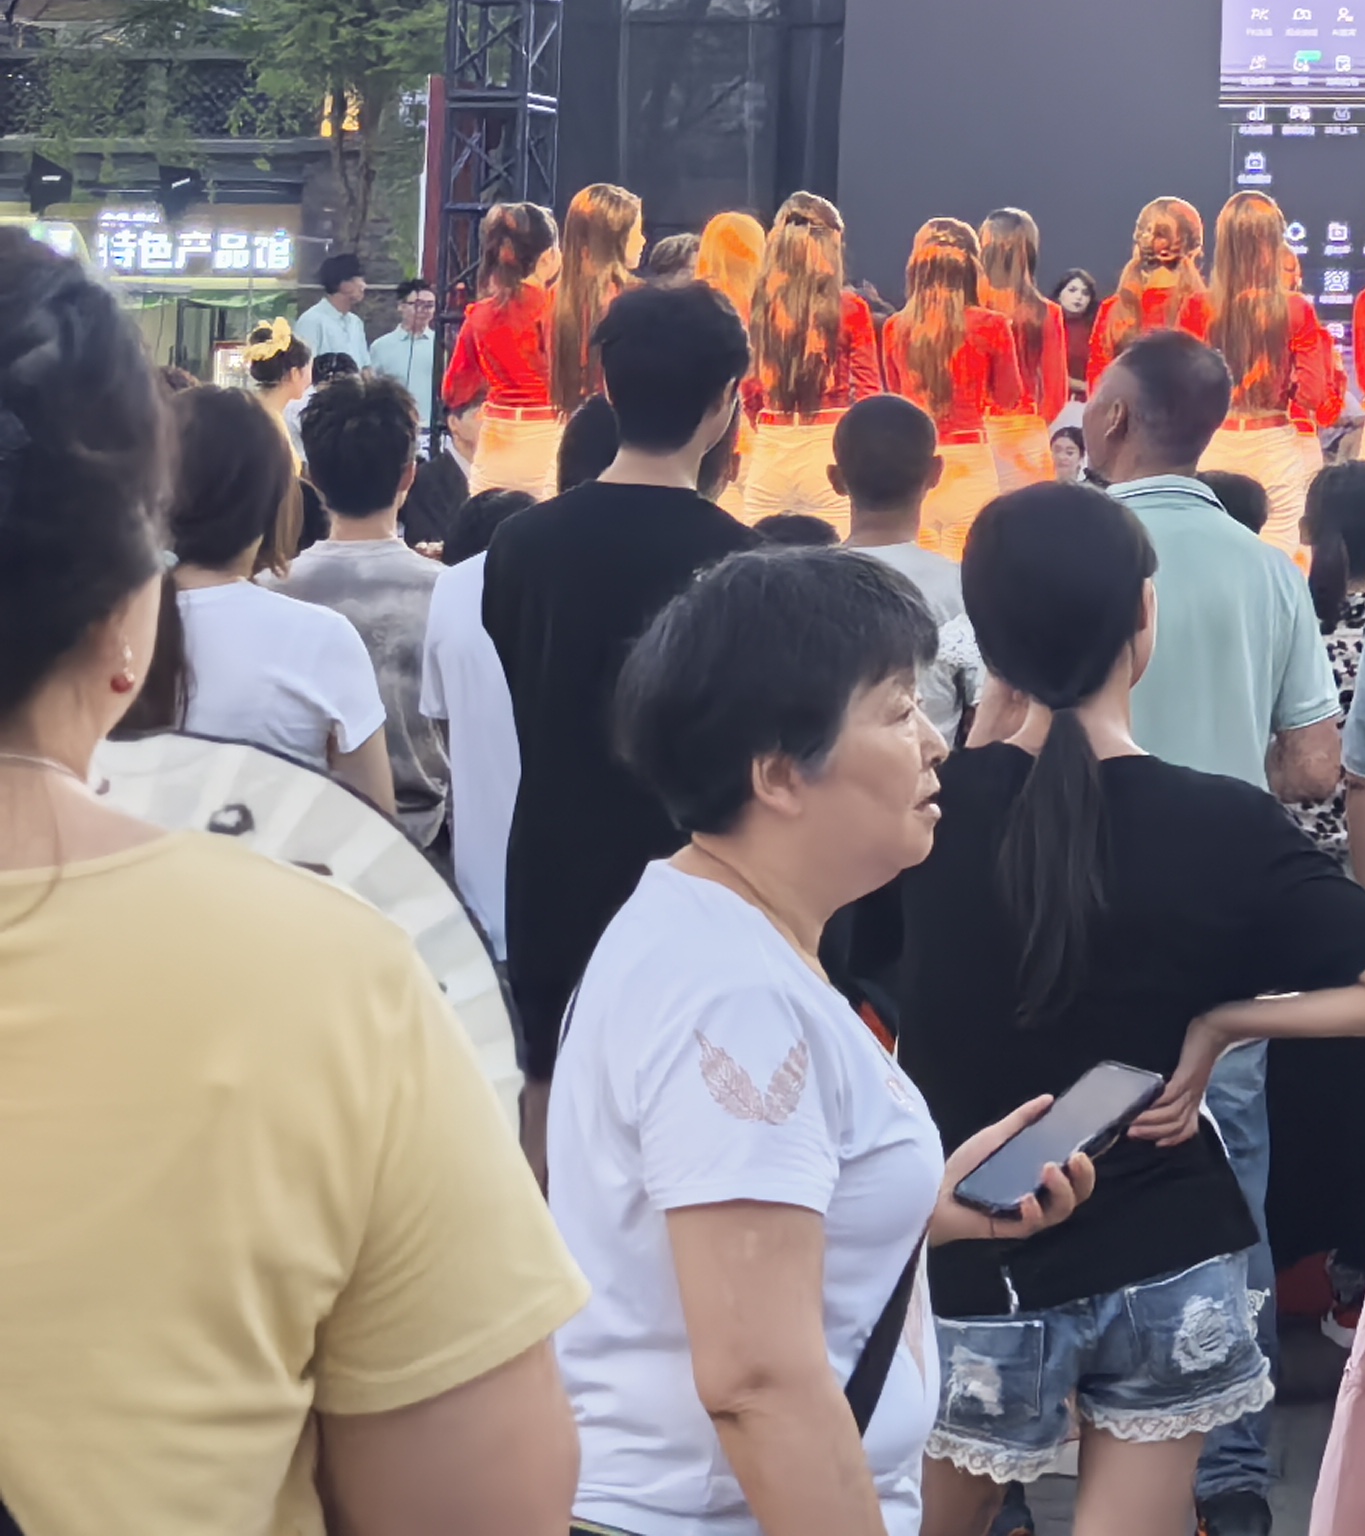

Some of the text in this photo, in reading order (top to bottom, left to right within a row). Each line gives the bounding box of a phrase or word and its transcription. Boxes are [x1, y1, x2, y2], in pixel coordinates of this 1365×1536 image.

[99, 229, 292, 270] 特色产品馆
